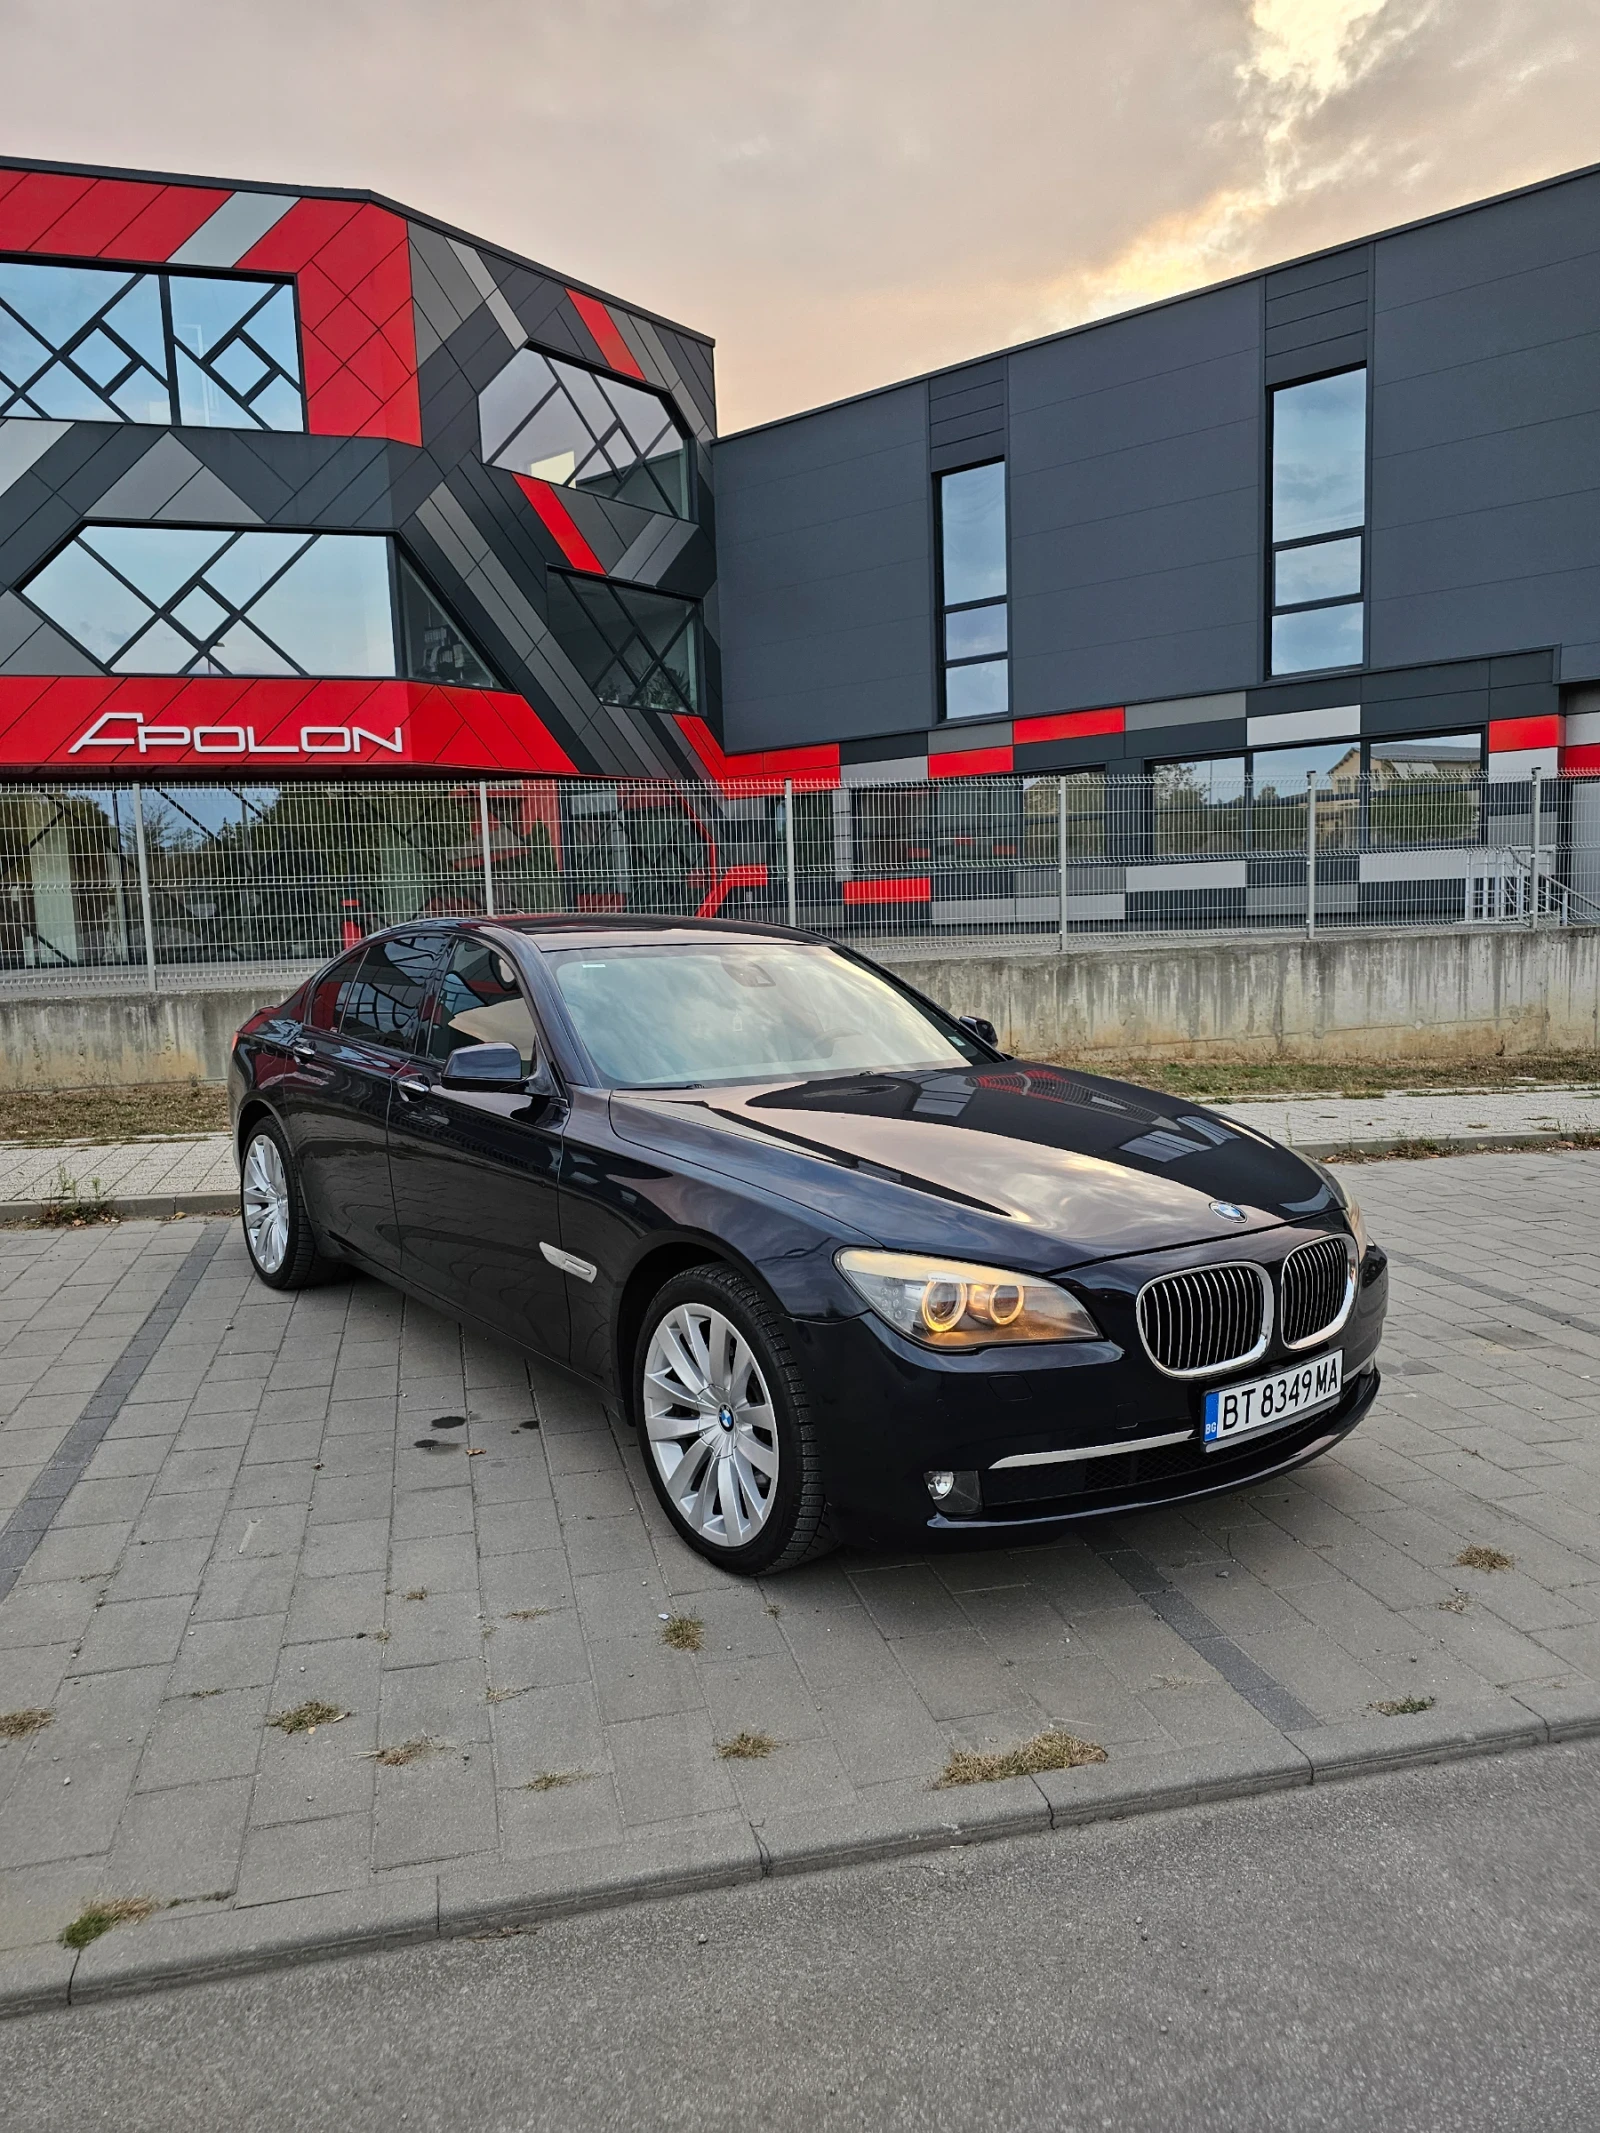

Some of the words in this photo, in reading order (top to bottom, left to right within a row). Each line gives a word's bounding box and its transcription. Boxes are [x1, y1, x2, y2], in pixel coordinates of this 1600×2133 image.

[67, 712, 403, 753] APOLON
[1222, 1388, 1256, 1430] BT
[1261, 1370, 1313, 1418] 8349
[1315, 1358, 1338, 1398] MA
[1205, 1422, 1217, 1435] BG
